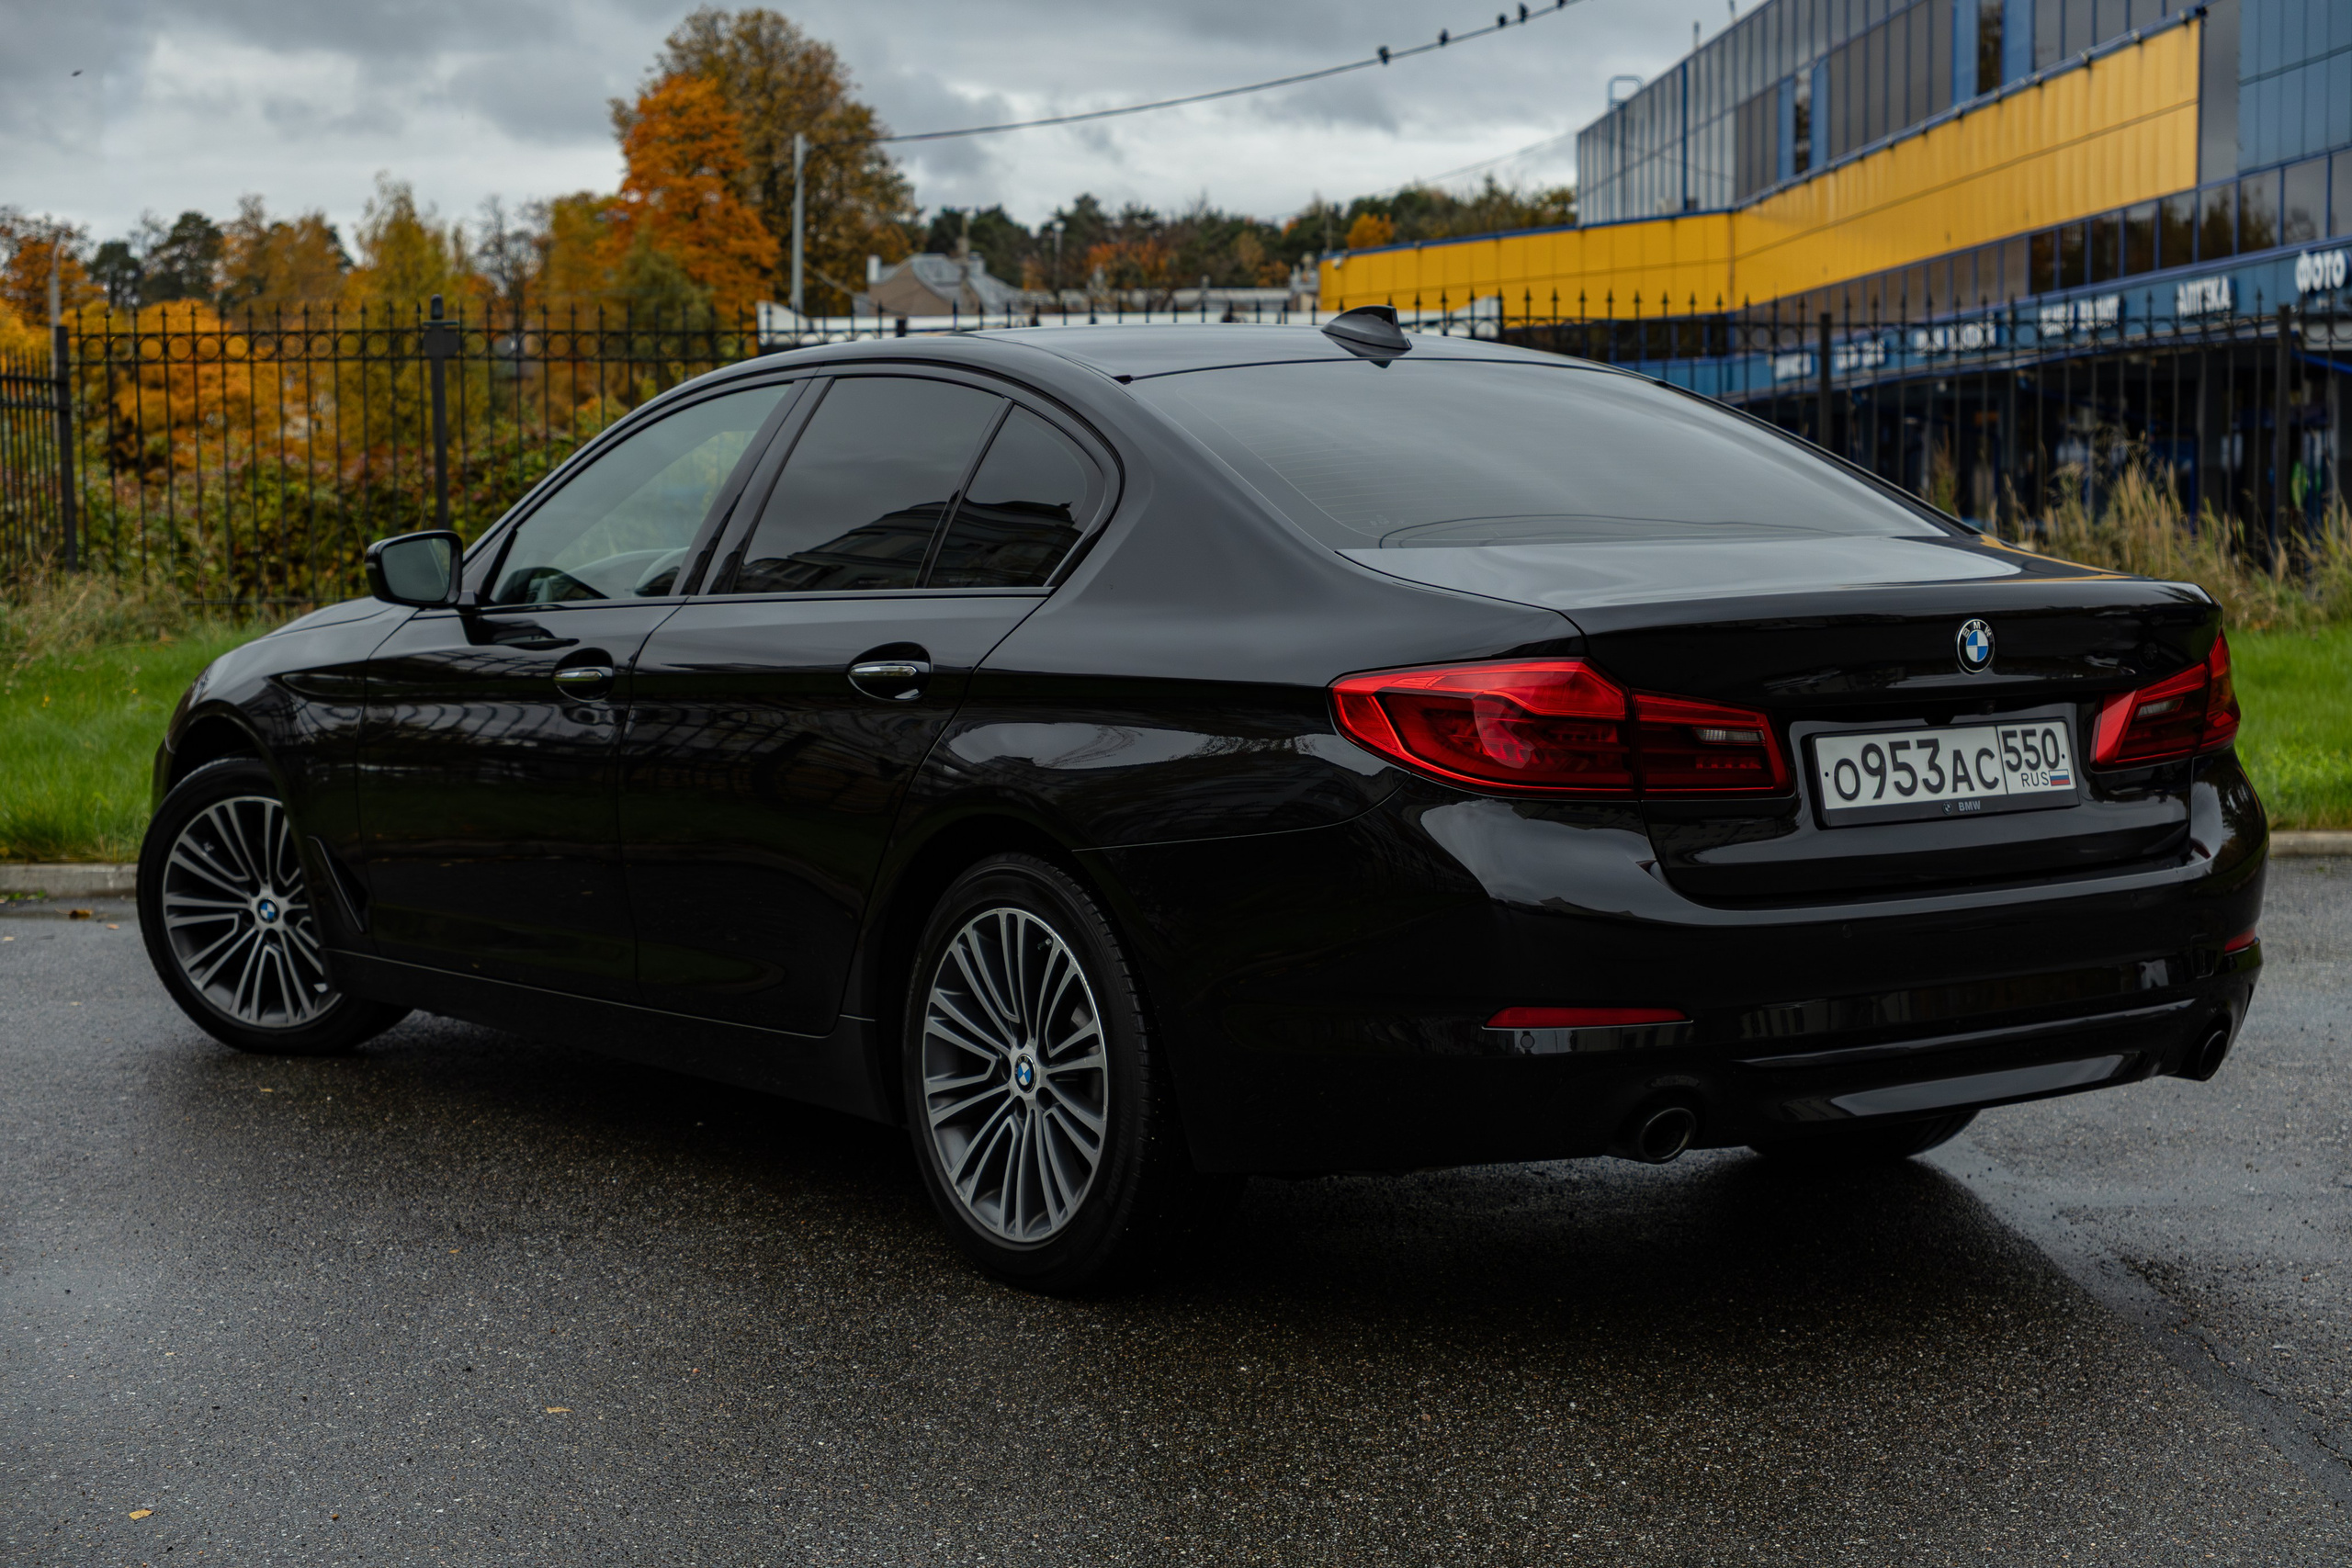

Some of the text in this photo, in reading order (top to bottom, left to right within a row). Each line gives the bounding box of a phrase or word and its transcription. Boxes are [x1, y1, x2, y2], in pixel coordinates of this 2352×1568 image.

[2294, 249, 2346, 293] ФОТО
[1962, 621, 1992, 637] BMW
[2001, 728, 2060, 773] 550
[2021, 771, 2050, 787] RUS
[1958, 800, 1981, 812] BMW
